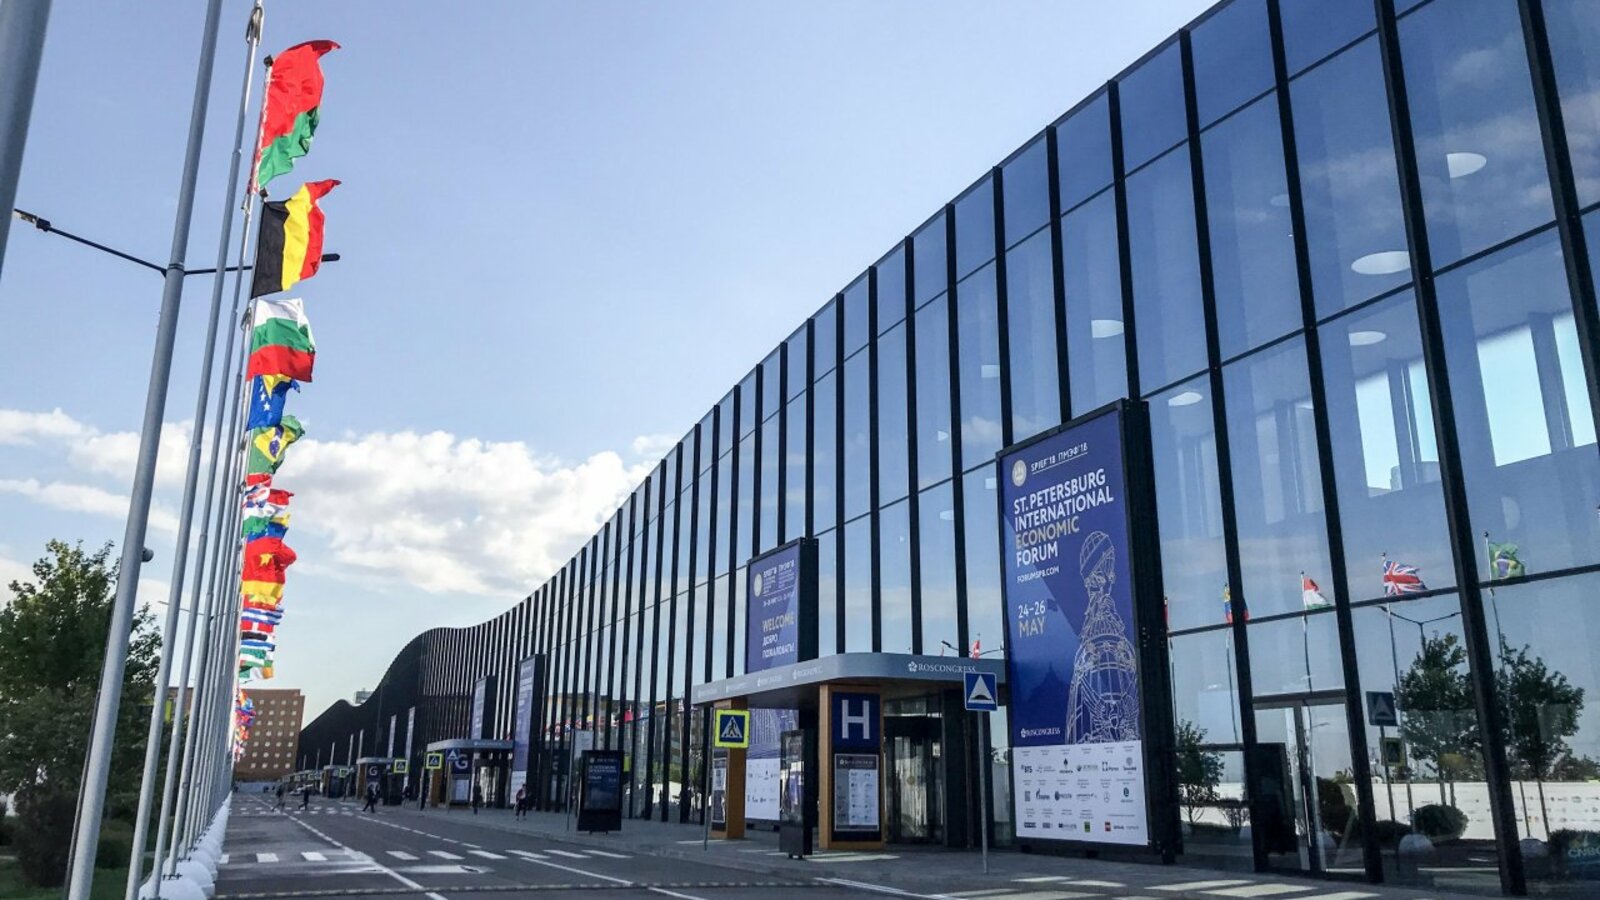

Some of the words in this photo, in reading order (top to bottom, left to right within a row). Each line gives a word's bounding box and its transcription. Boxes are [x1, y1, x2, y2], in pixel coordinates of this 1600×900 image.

[1013, 496, 1028, 514] ST.
[1029, 468, 1105, 509] PETERSBURG
[1015, 486, 1114, 532] INTERNATIONAL
[1015, 516, 1080, 550] ECONOMIC
[1016, 541, 1058, 568] FORUM
[1019, 616, 1045, 638] MAY
[918, 663, 976, 673] ROSCONGRESS
[841, 699, 870, 739] H
[455, 754, 468, 769] G
